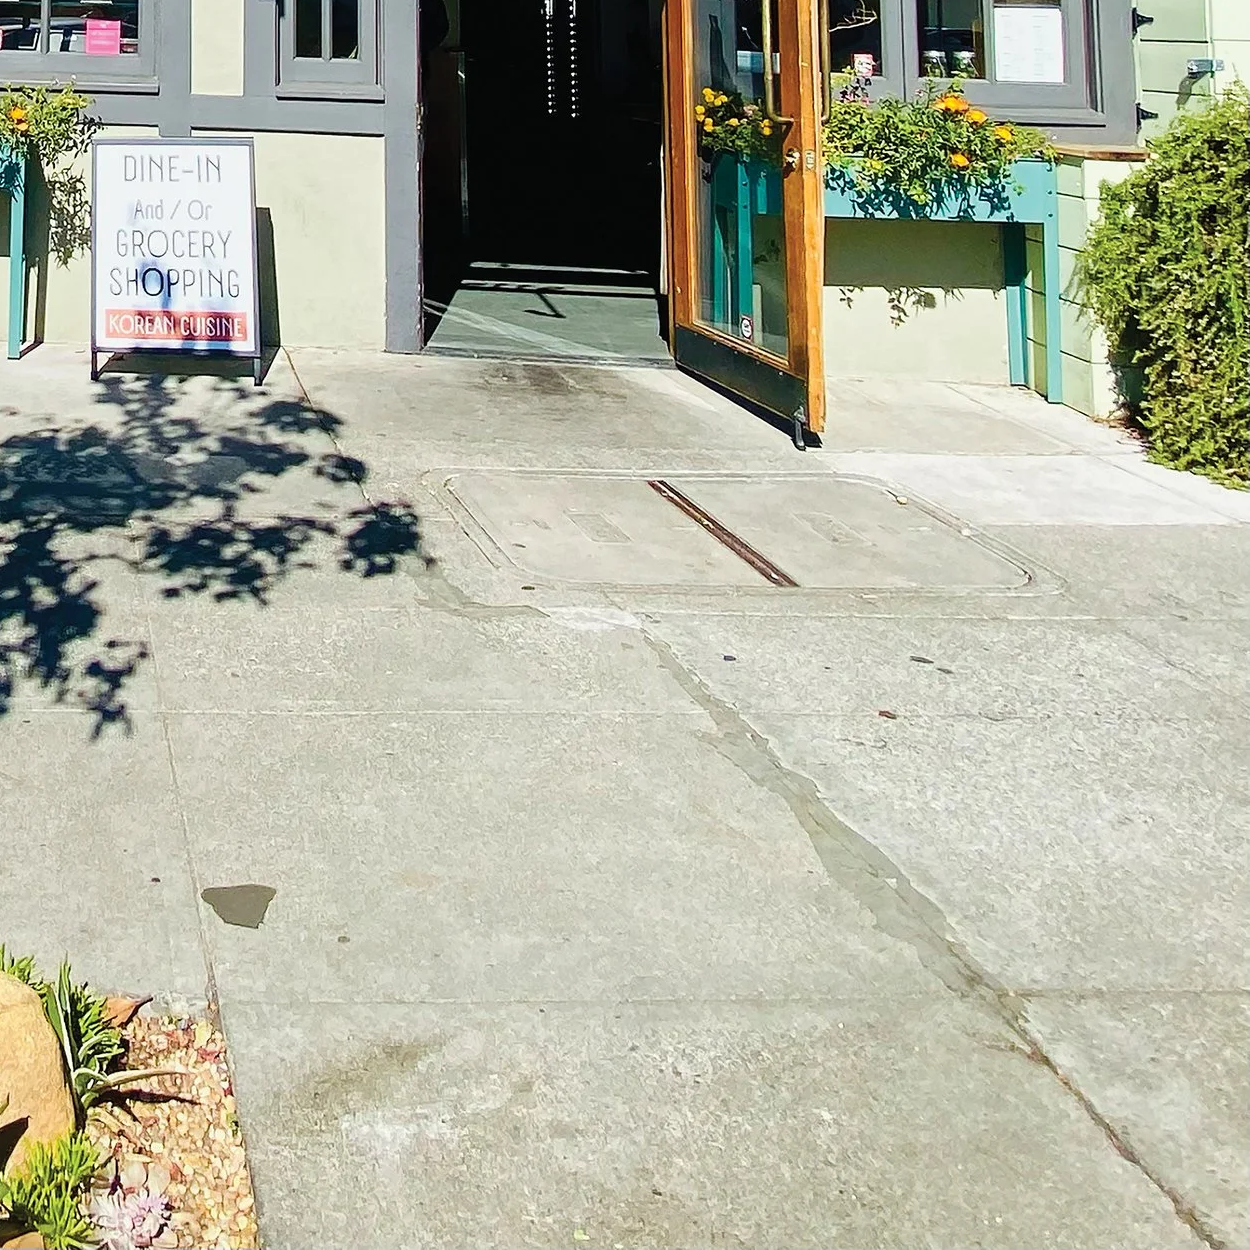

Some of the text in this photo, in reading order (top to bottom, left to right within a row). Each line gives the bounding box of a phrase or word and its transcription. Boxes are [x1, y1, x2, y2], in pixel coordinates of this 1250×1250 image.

[123, 155, 222, 183] DINE-IN
[133, 199, 164, 220] And
[187, 199, 213, 220] Or
[116, 229, 233, 259] GROCERY
[109, 267, 240, 298] SHOPPING
[109, 313, 244, 338] KOREAN CUISINE
